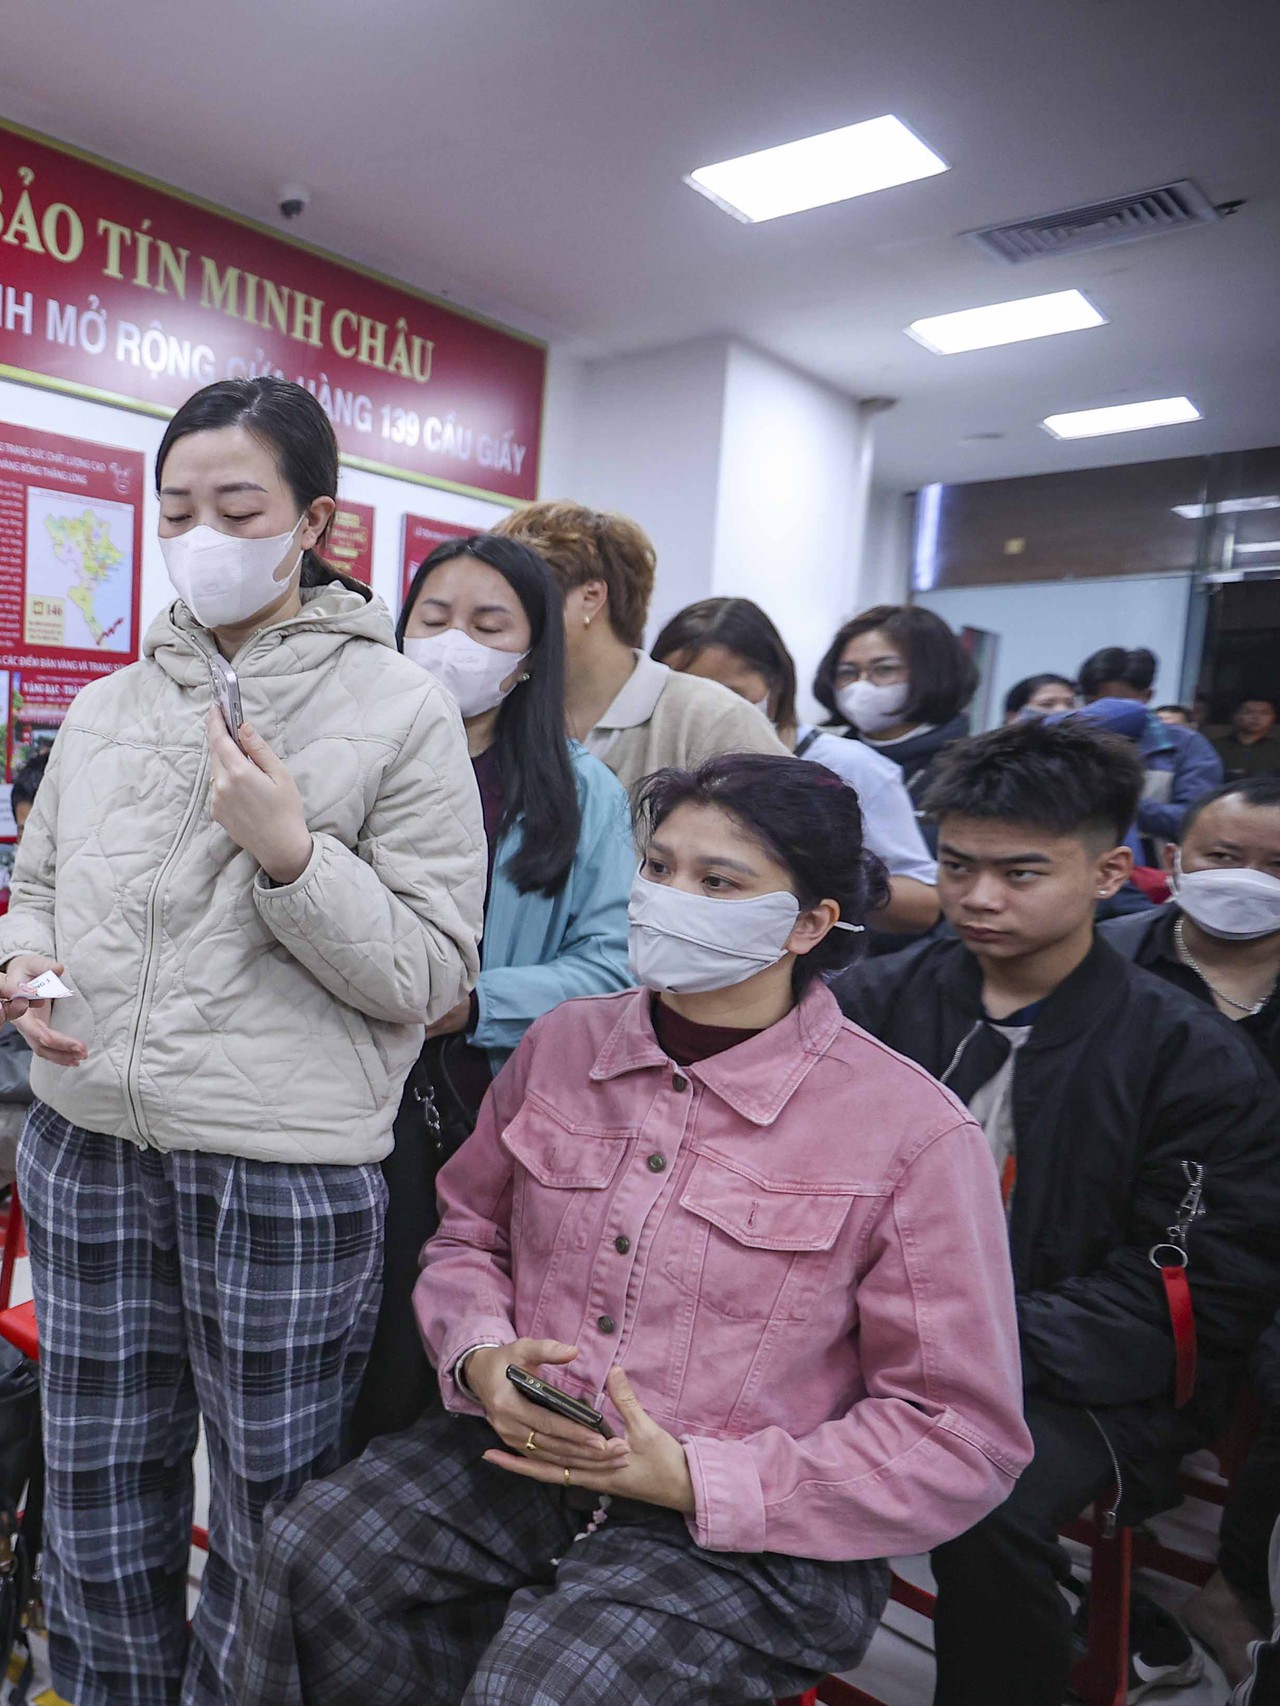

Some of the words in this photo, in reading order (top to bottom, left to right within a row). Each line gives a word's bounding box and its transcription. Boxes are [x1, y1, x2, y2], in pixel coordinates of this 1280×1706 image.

[46, 294, 107, 355] MỞ
[116, 319, 216, 385] RỘNG
[380, 404, 420, 448] 139
[423, 409, 473, 462] CẦU
[477, 428, 527, 476] GIẤY
[96, 218, 190, 300] TÍN
[200, 255, 325, 348] MINH
[330, 308, 435, 384] CHÂU
